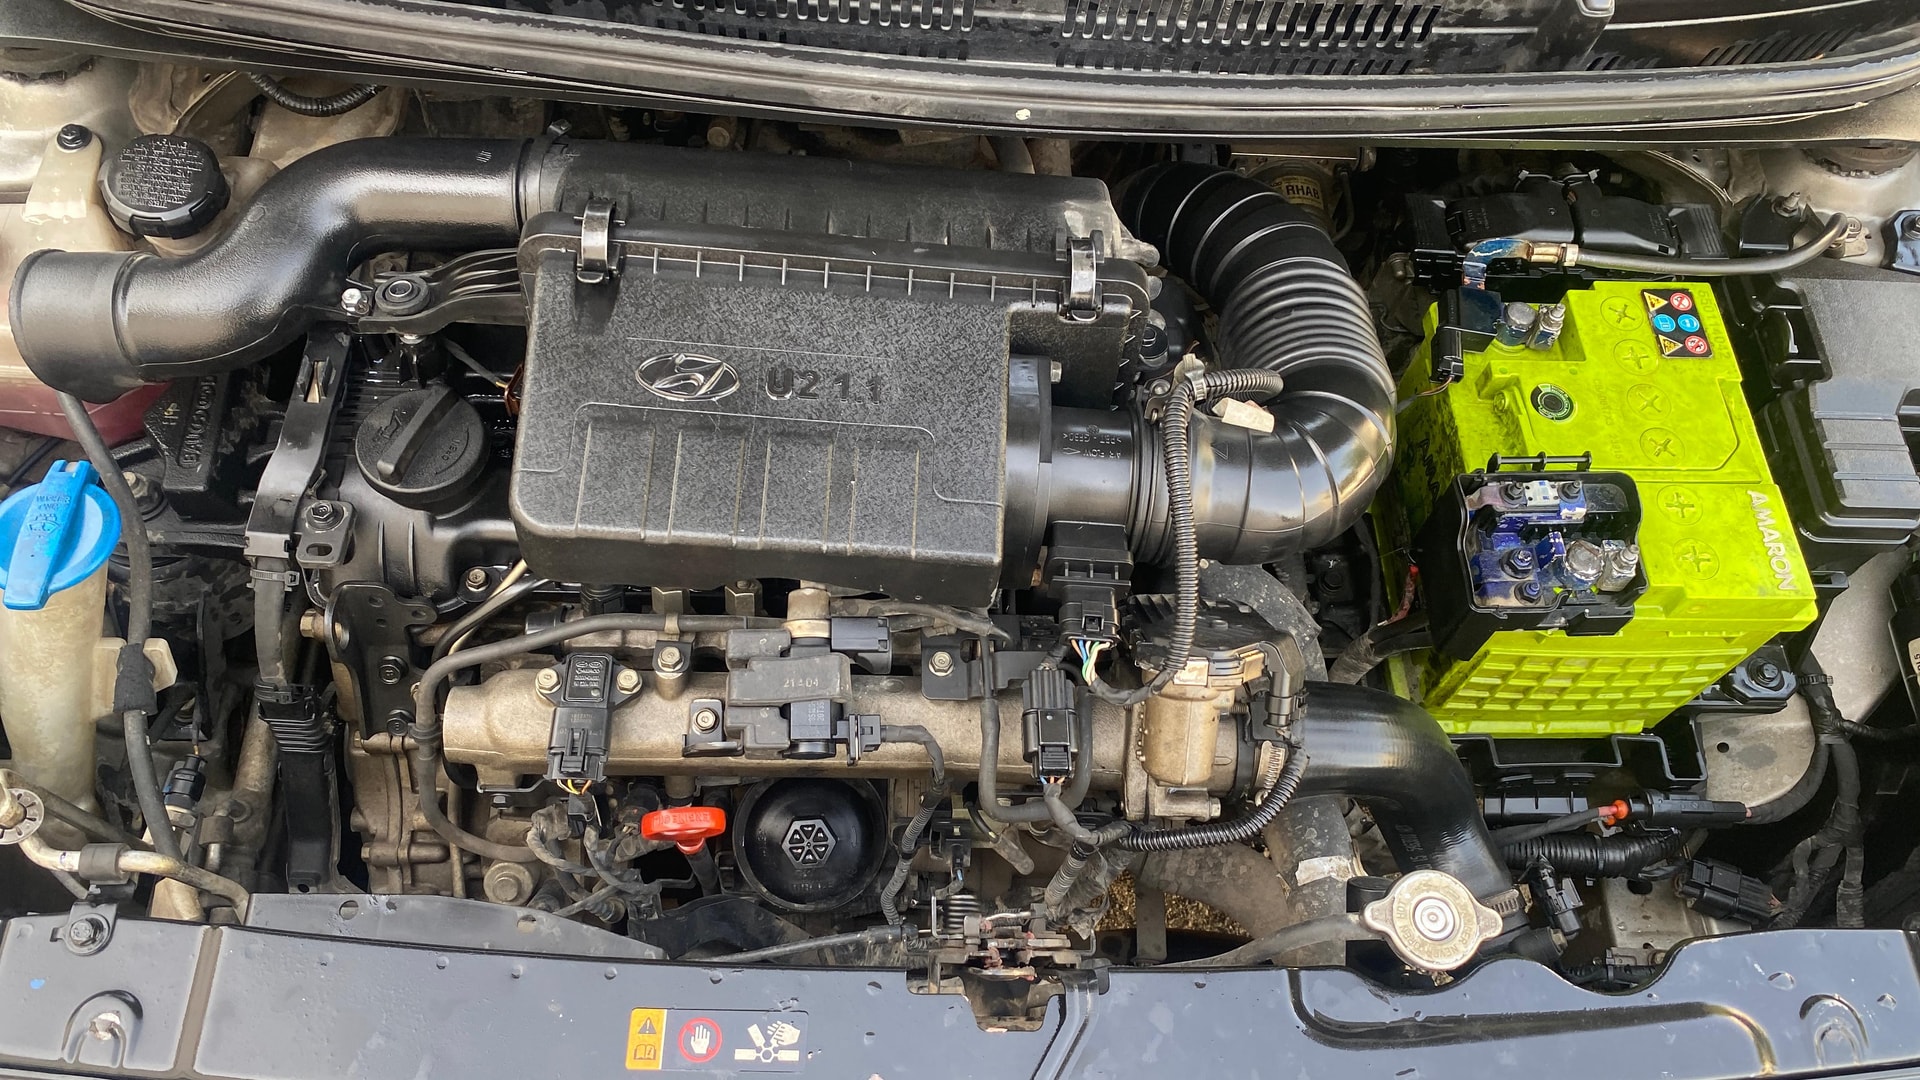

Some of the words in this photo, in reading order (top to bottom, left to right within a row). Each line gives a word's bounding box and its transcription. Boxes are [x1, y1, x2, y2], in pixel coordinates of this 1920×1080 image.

[1285, 183, 1320, 200] RHAB
[765, 367, 820, 402] U2
[441, 438, 461, 461] OPEN
[1747, 489, 1798, 591] AMARON
[1395, 898, 1408, 919] HOT
